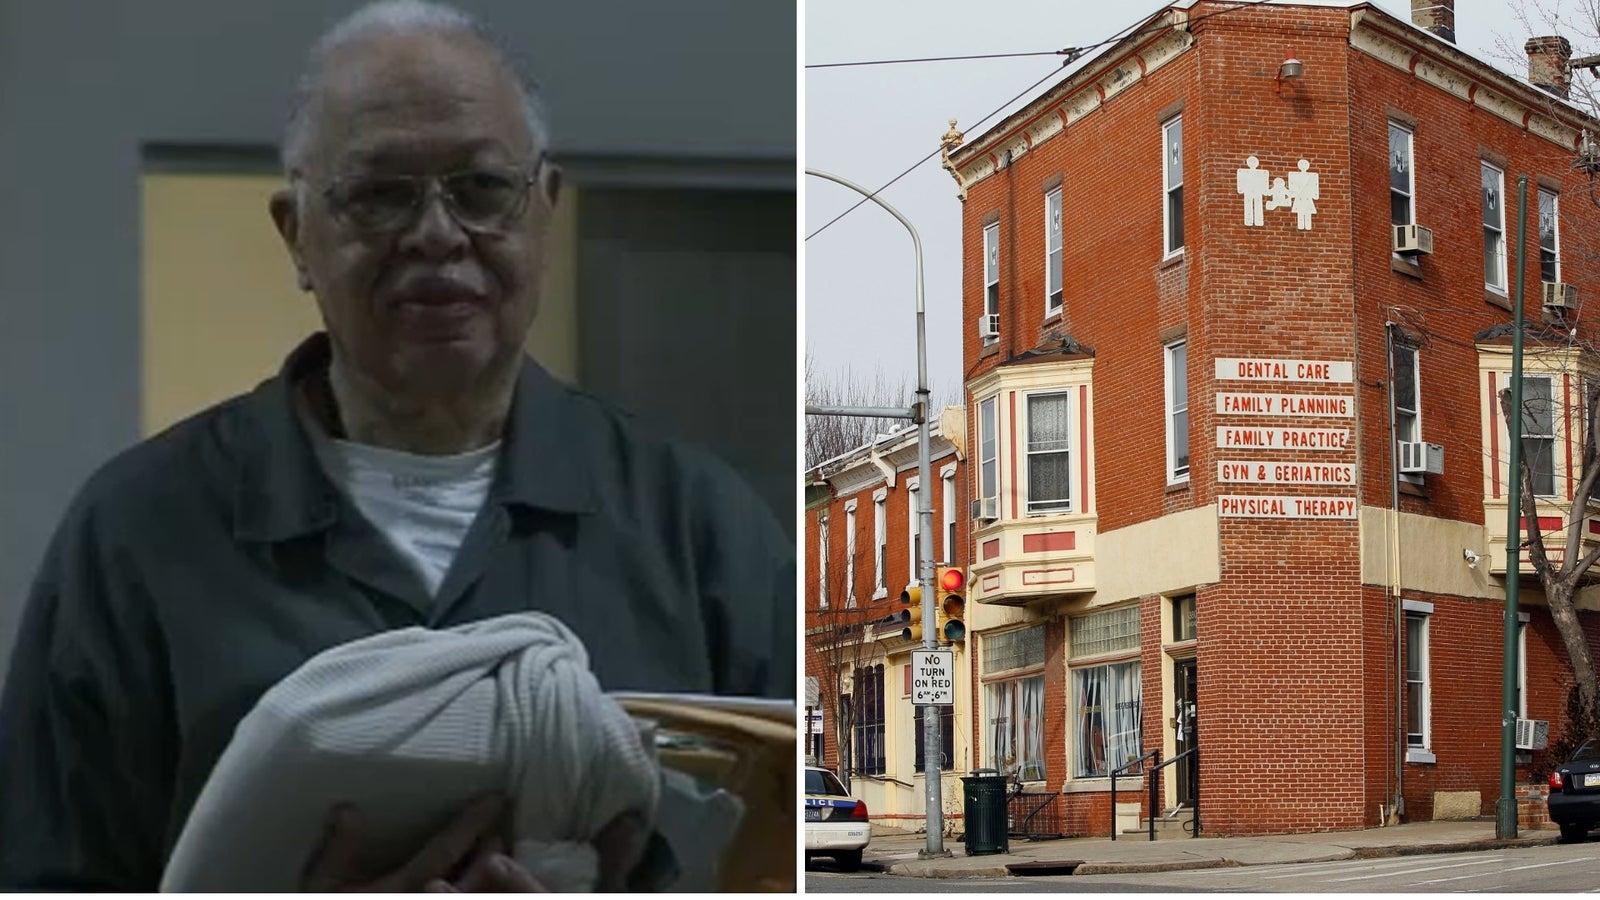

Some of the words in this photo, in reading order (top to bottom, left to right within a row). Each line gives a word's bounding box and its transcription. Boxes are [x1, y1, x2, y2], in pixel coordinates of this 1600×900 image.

[1238, 362, 1288, 379] DENTAL
[1297, 364, 1330, 380] CARE
[1224, 396, 1272, 412] FAMILY
[1281, 398, 1347, 414] PLANNING
[1226, 430, 1274, 446] FAMILY
[1282, 431, 1345, 448] PRACTICE
[1222, 464, 1249, 480] GYN
[1257, 465, 1266, 480] &
[1275, 465, 1351, 482] GERIATRICS
[1221, 499, 1286, 515] PHYSICAL
[1295, 500, 1354, 516] THERAPY
[925, 656, 940, 665] NO
[920, 668, 945, 677] TURN
[915, 679, 928, 688] ON
[931, 679, 951, 688] RED
